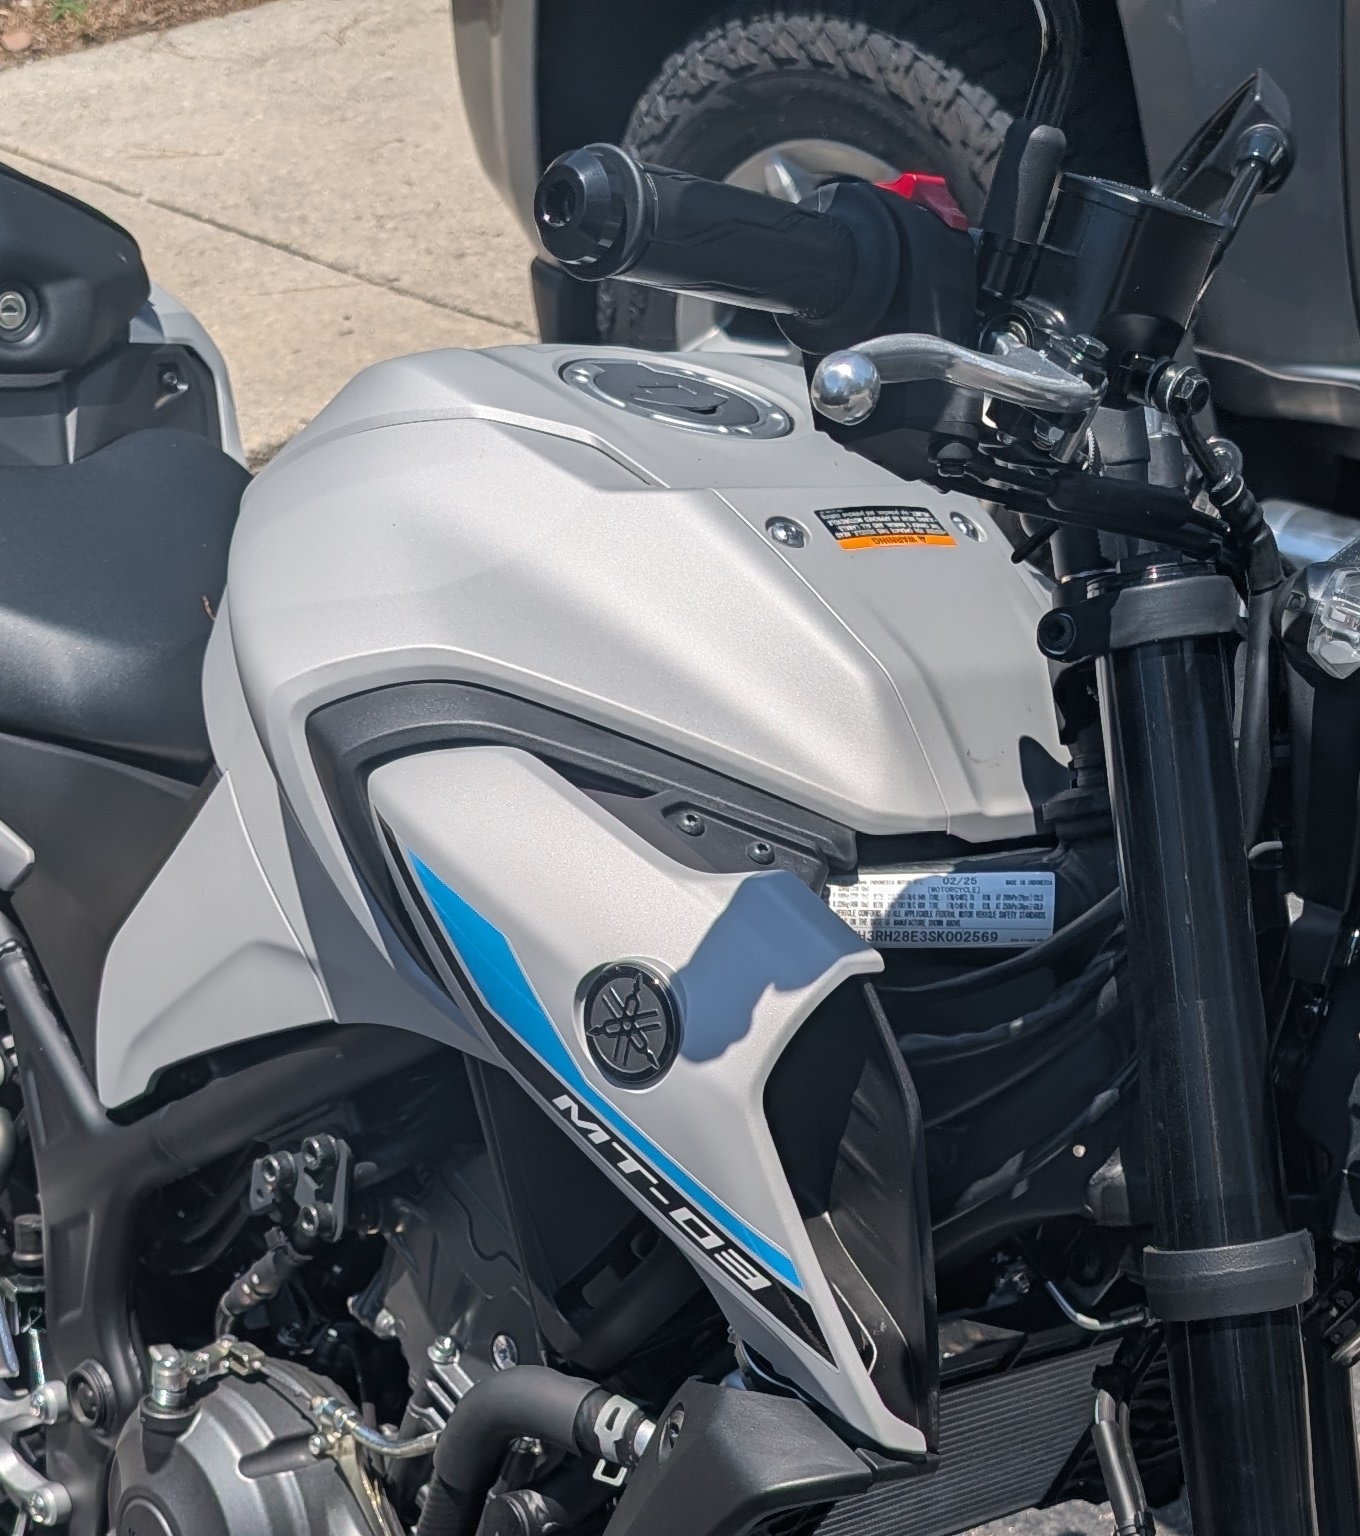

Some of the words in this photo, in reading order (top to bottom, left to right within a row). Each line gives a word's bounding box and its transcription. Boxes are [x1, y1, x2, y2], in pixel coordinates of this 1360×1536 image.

[871, 536, 918, 545] WARNING
[942, 876, 978, 886] 02/25
[857, 930, 998, 943] H3RH28E3SK002569
[551, 1093, 773, 1292] MT-03
